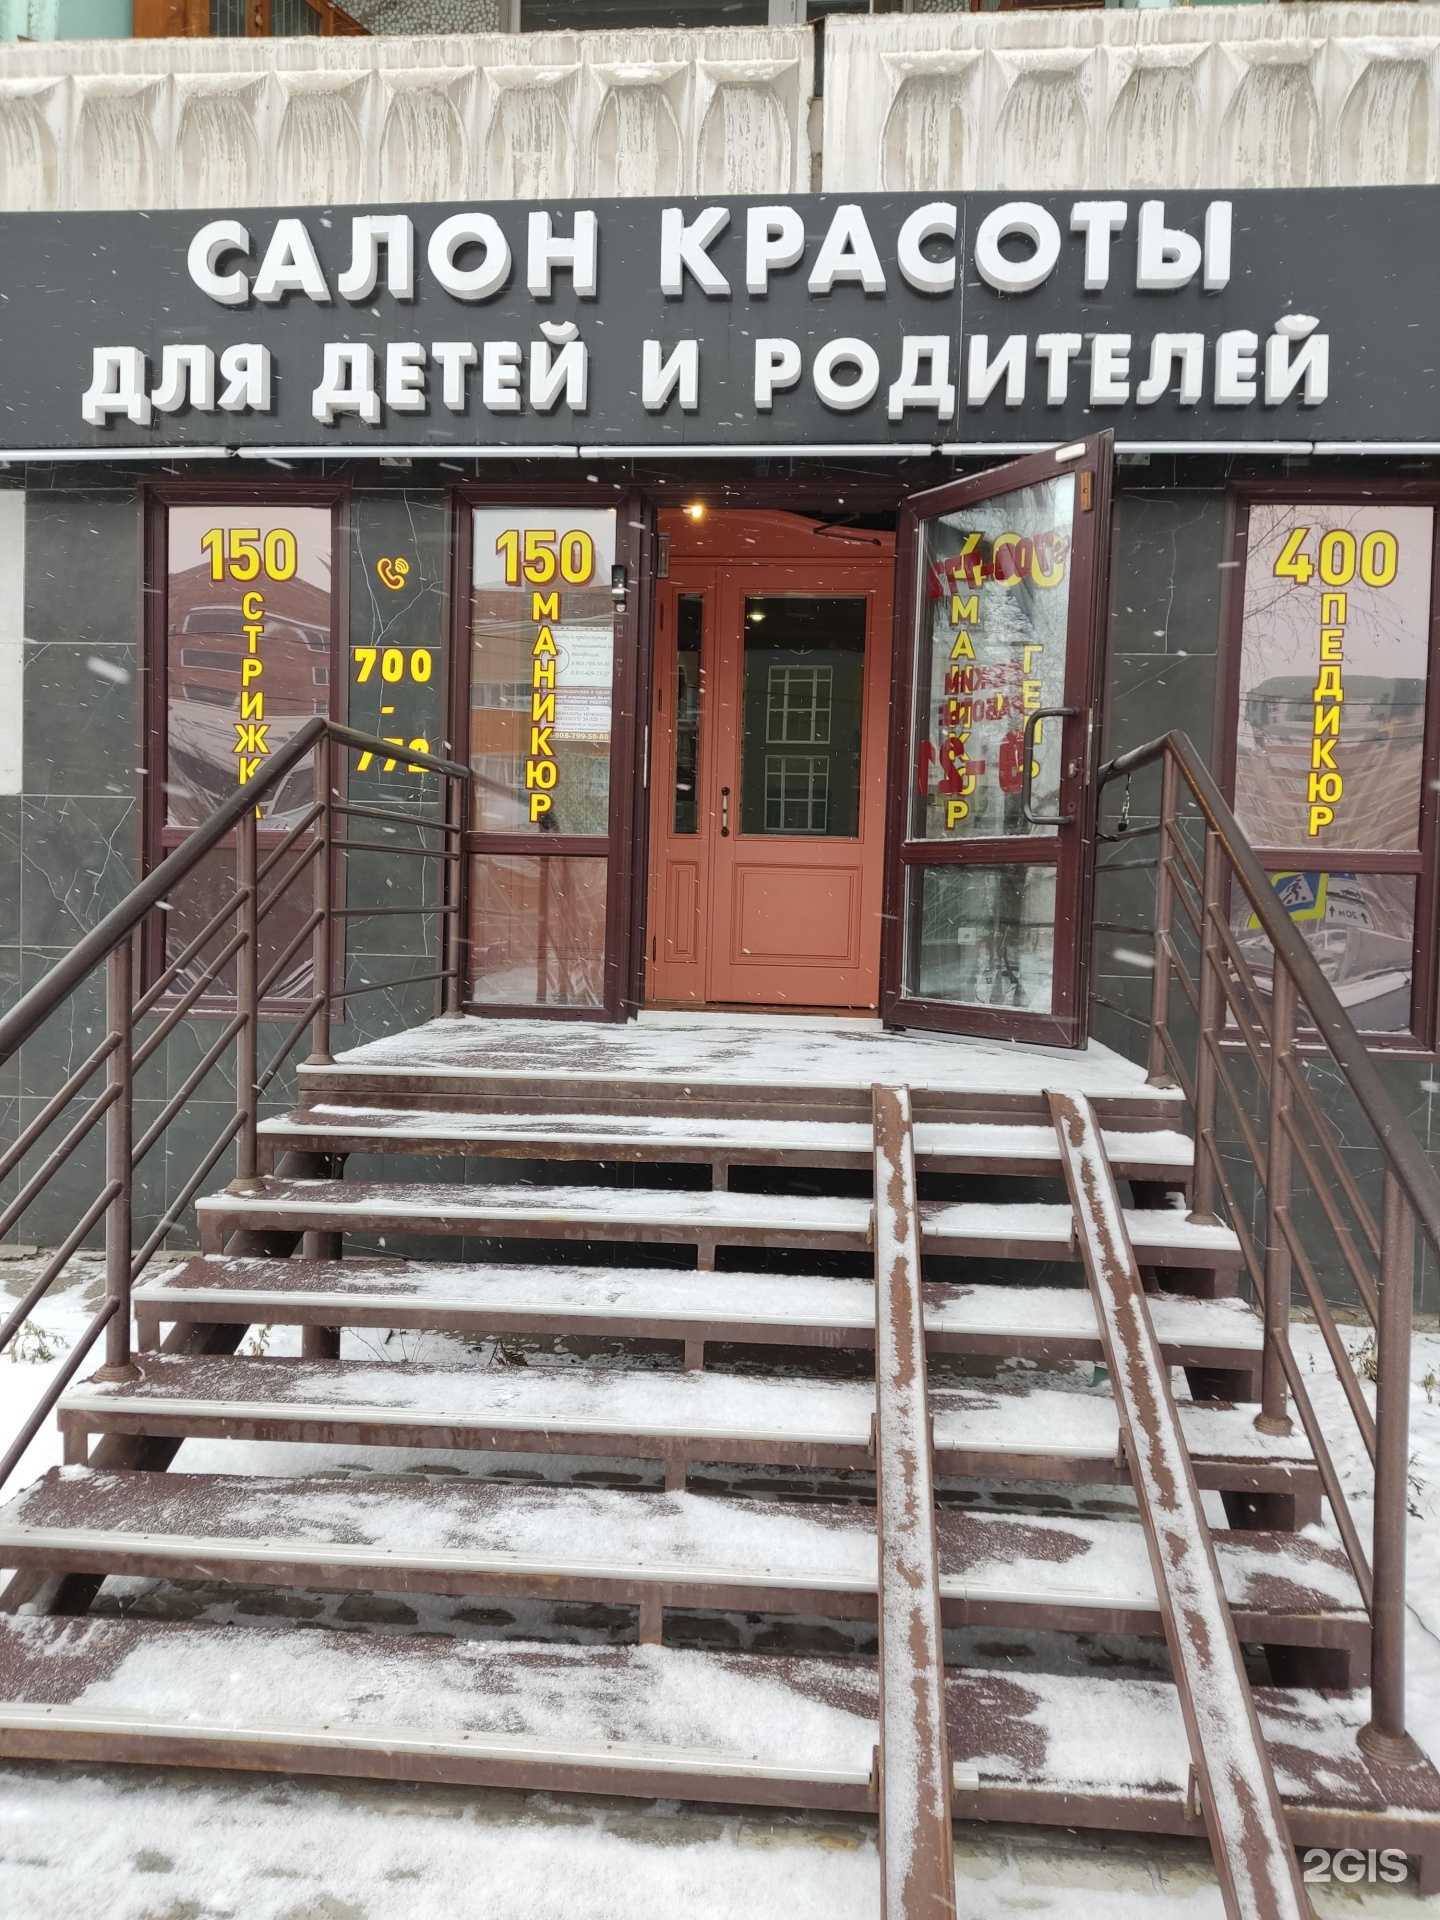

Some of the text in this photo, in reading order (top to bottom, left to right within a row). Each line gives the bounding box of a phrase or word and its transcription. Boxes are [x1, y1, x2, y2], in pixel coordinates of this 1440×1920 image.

[187, 200, 1233, 305] САЛОН КРАСОТЫ
[82, 312, 1330, 427] ДЛЯ ДЕТЕЙ И РОДИТЕЛЕЙ
[200, 527, 298, 583] 150
[495, 528, 595, 585] 150
[1273, 527, 1399, 589] 400
[232, 591, 271, 819] СТРИЖК
[354, 648, 432, 683] 700
[526, 590, 561, 824] МАНИКЮР
[1307, 591, 1348, 838] ПЕДИКЮР
